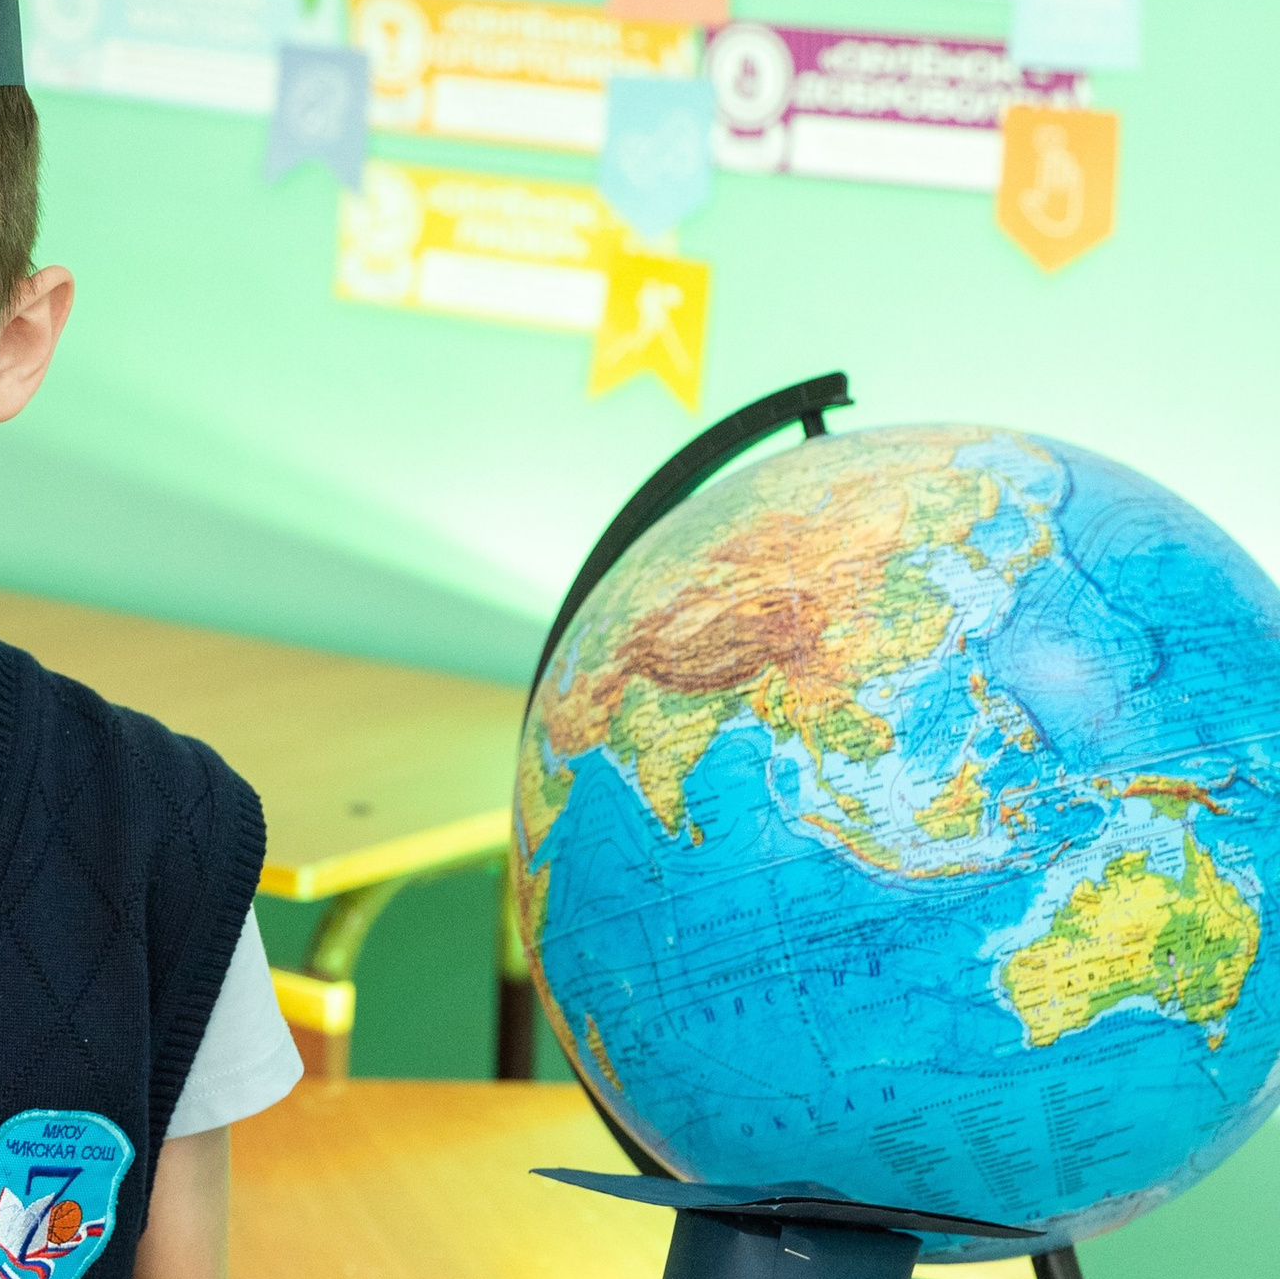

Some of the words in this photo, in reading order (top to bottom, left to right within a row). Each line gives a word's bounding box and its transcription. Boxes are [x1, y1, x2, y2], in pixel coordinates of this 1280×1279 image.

[6, 1139, 76, 1160] ЧИКСКАЯ
[81, 1145, 115, 1161] СОШ
[20, 1165, 84, 1264] 7
